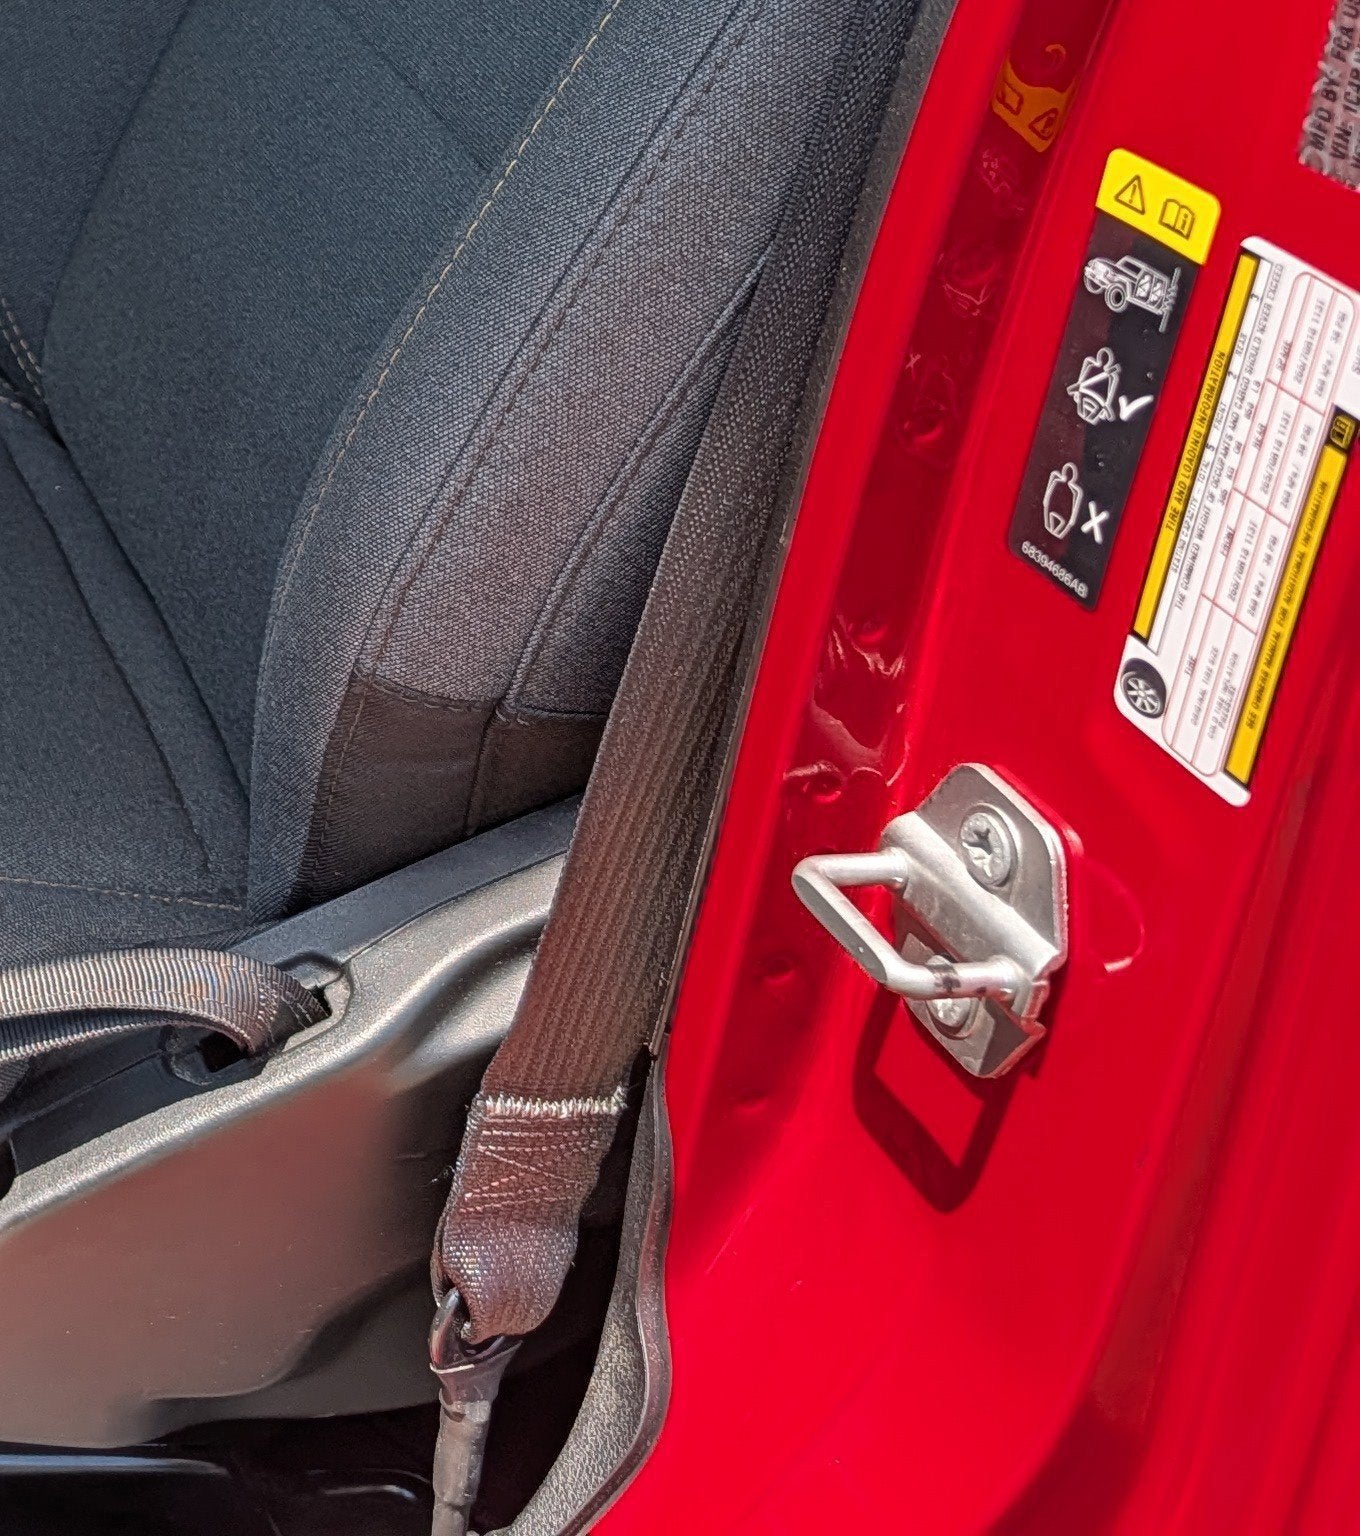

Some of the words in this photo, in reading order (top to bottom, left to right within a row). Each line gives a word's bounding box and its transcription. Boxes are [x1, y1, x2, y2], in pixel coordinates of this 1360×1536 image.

[1307, 105, 1332, 152] MFD
[1329, 21, 1354, 63] FCA
[1329, 118, 1353, 163] VIN:
[1166, 507, 1179, 532] TIRE
[1174, 481, 1187, 504] AND
[1182, 430, 1202, 479] LOADING
[1197, 350, 1226, 428] INFORMATION
[1175, 593, 1185, 611] THE
[1181, 543, 1200, 591] COMBINED
[1196, 506, 1211, 541] WEIGHT
[1207, 490, 1215, 503] OF
[1211, 433, 1233, 490] OCCUPANTS
[1228, 412, 1239, 432] AND
[1234, 377, 1250, 410] CARGO
[1245, 337, 1262, 375] SHOULD
[1257, 303, 1272, 335] NEVER
[1267, 263, 1284, 301] EXCEED
[1301, 481, 1328, 549] INFORMATION
[1282, 550, 1305, 606] ADDITIONAL
[1276, 607, 1287, 627] FOR
[1263, 629, 1281, 669] MANUAL
[1251, 670, 1269, 711] OWNERS
[1246, 712, 1257, 730] SEE
